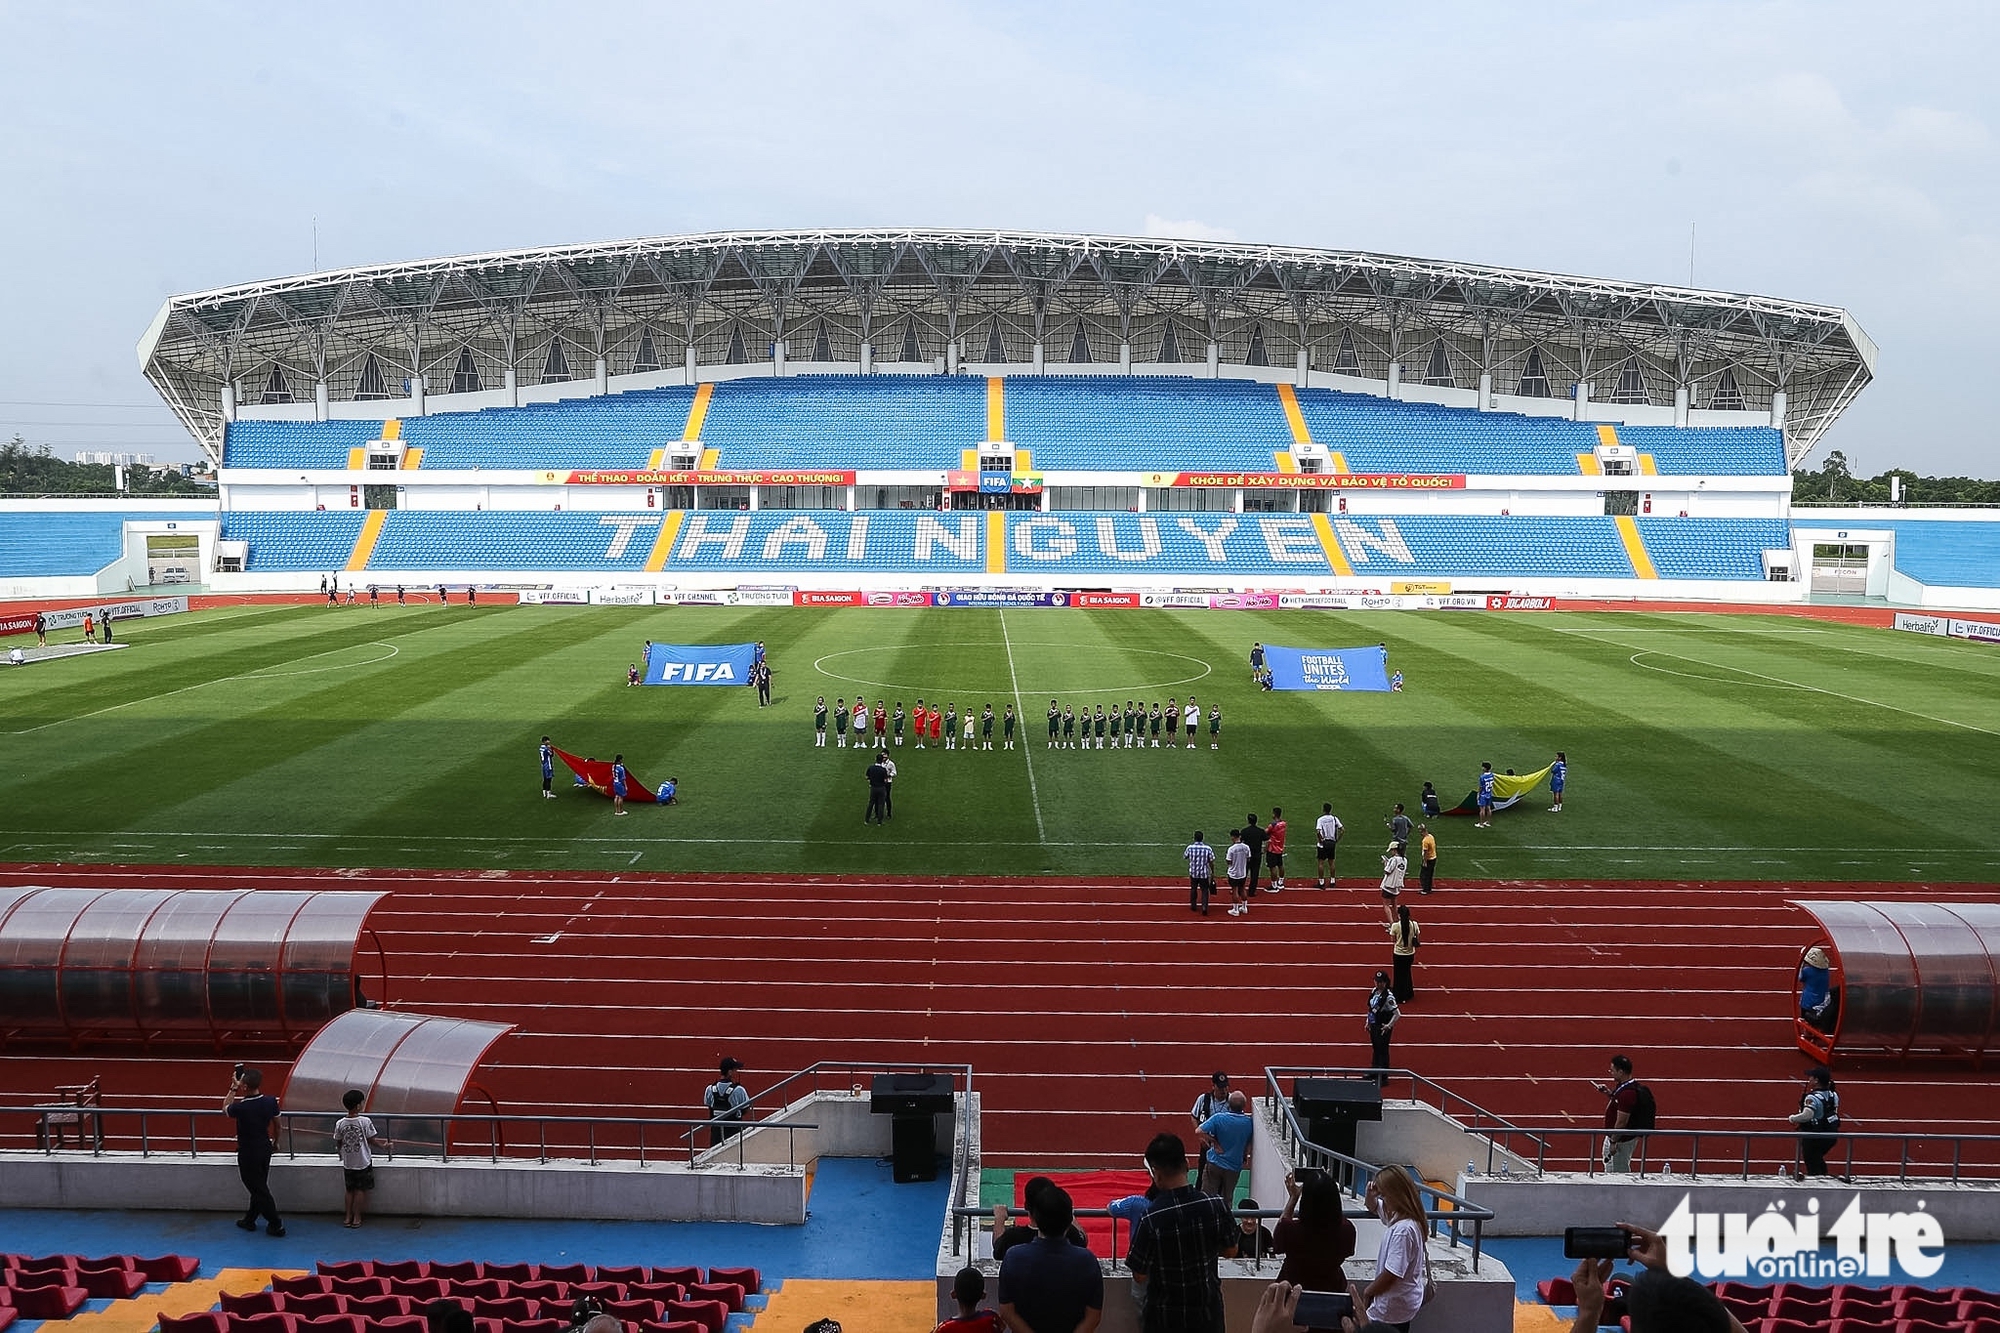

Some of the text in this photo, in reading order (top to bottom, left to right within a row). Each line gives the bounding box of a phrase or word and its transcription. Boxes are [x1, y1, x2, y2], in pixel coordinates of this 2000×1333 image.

[578, 471, 598, 483] THỂ
[600, 474, 628, 483] THAO
[636, 472, 667, 483] ĐOÀN
[669, 471, 690, 483] KẾT
[697, 474, 732, 483] TRUNG
[735, 473, 763, 484] THỰC
[771, 474, 794, 483] CAO
[797, 473, 844, 485] THƯỢNG!
[983, 477, 1007, 487] FIFA
[1190, 474, 1224, 485] KHỎE
[1248, 475, 1276, 485] XÂY
[1279, 476, 1316, 487] DỰNG
[1319, 476, 1338, 486] VÀ
[1341, 475, 1368, 486] BẢO
[1372, 476, 1387, 488] VỆ
[599, 515, 1415, 563] THAI NGUYEN
[600, 594, 640, 604] Herbalife
[1902, 619, 1936, 634] Herbalife
[1967, 624, 2000, 637] VFF.OFFICIA
[1301, 655, 1343, 665] FOOTBALL
[662, 662, 735, 681] FIFA
[1303, 664, 1345, 676] UNITES
[1302, 675, 1350, 685] the World
